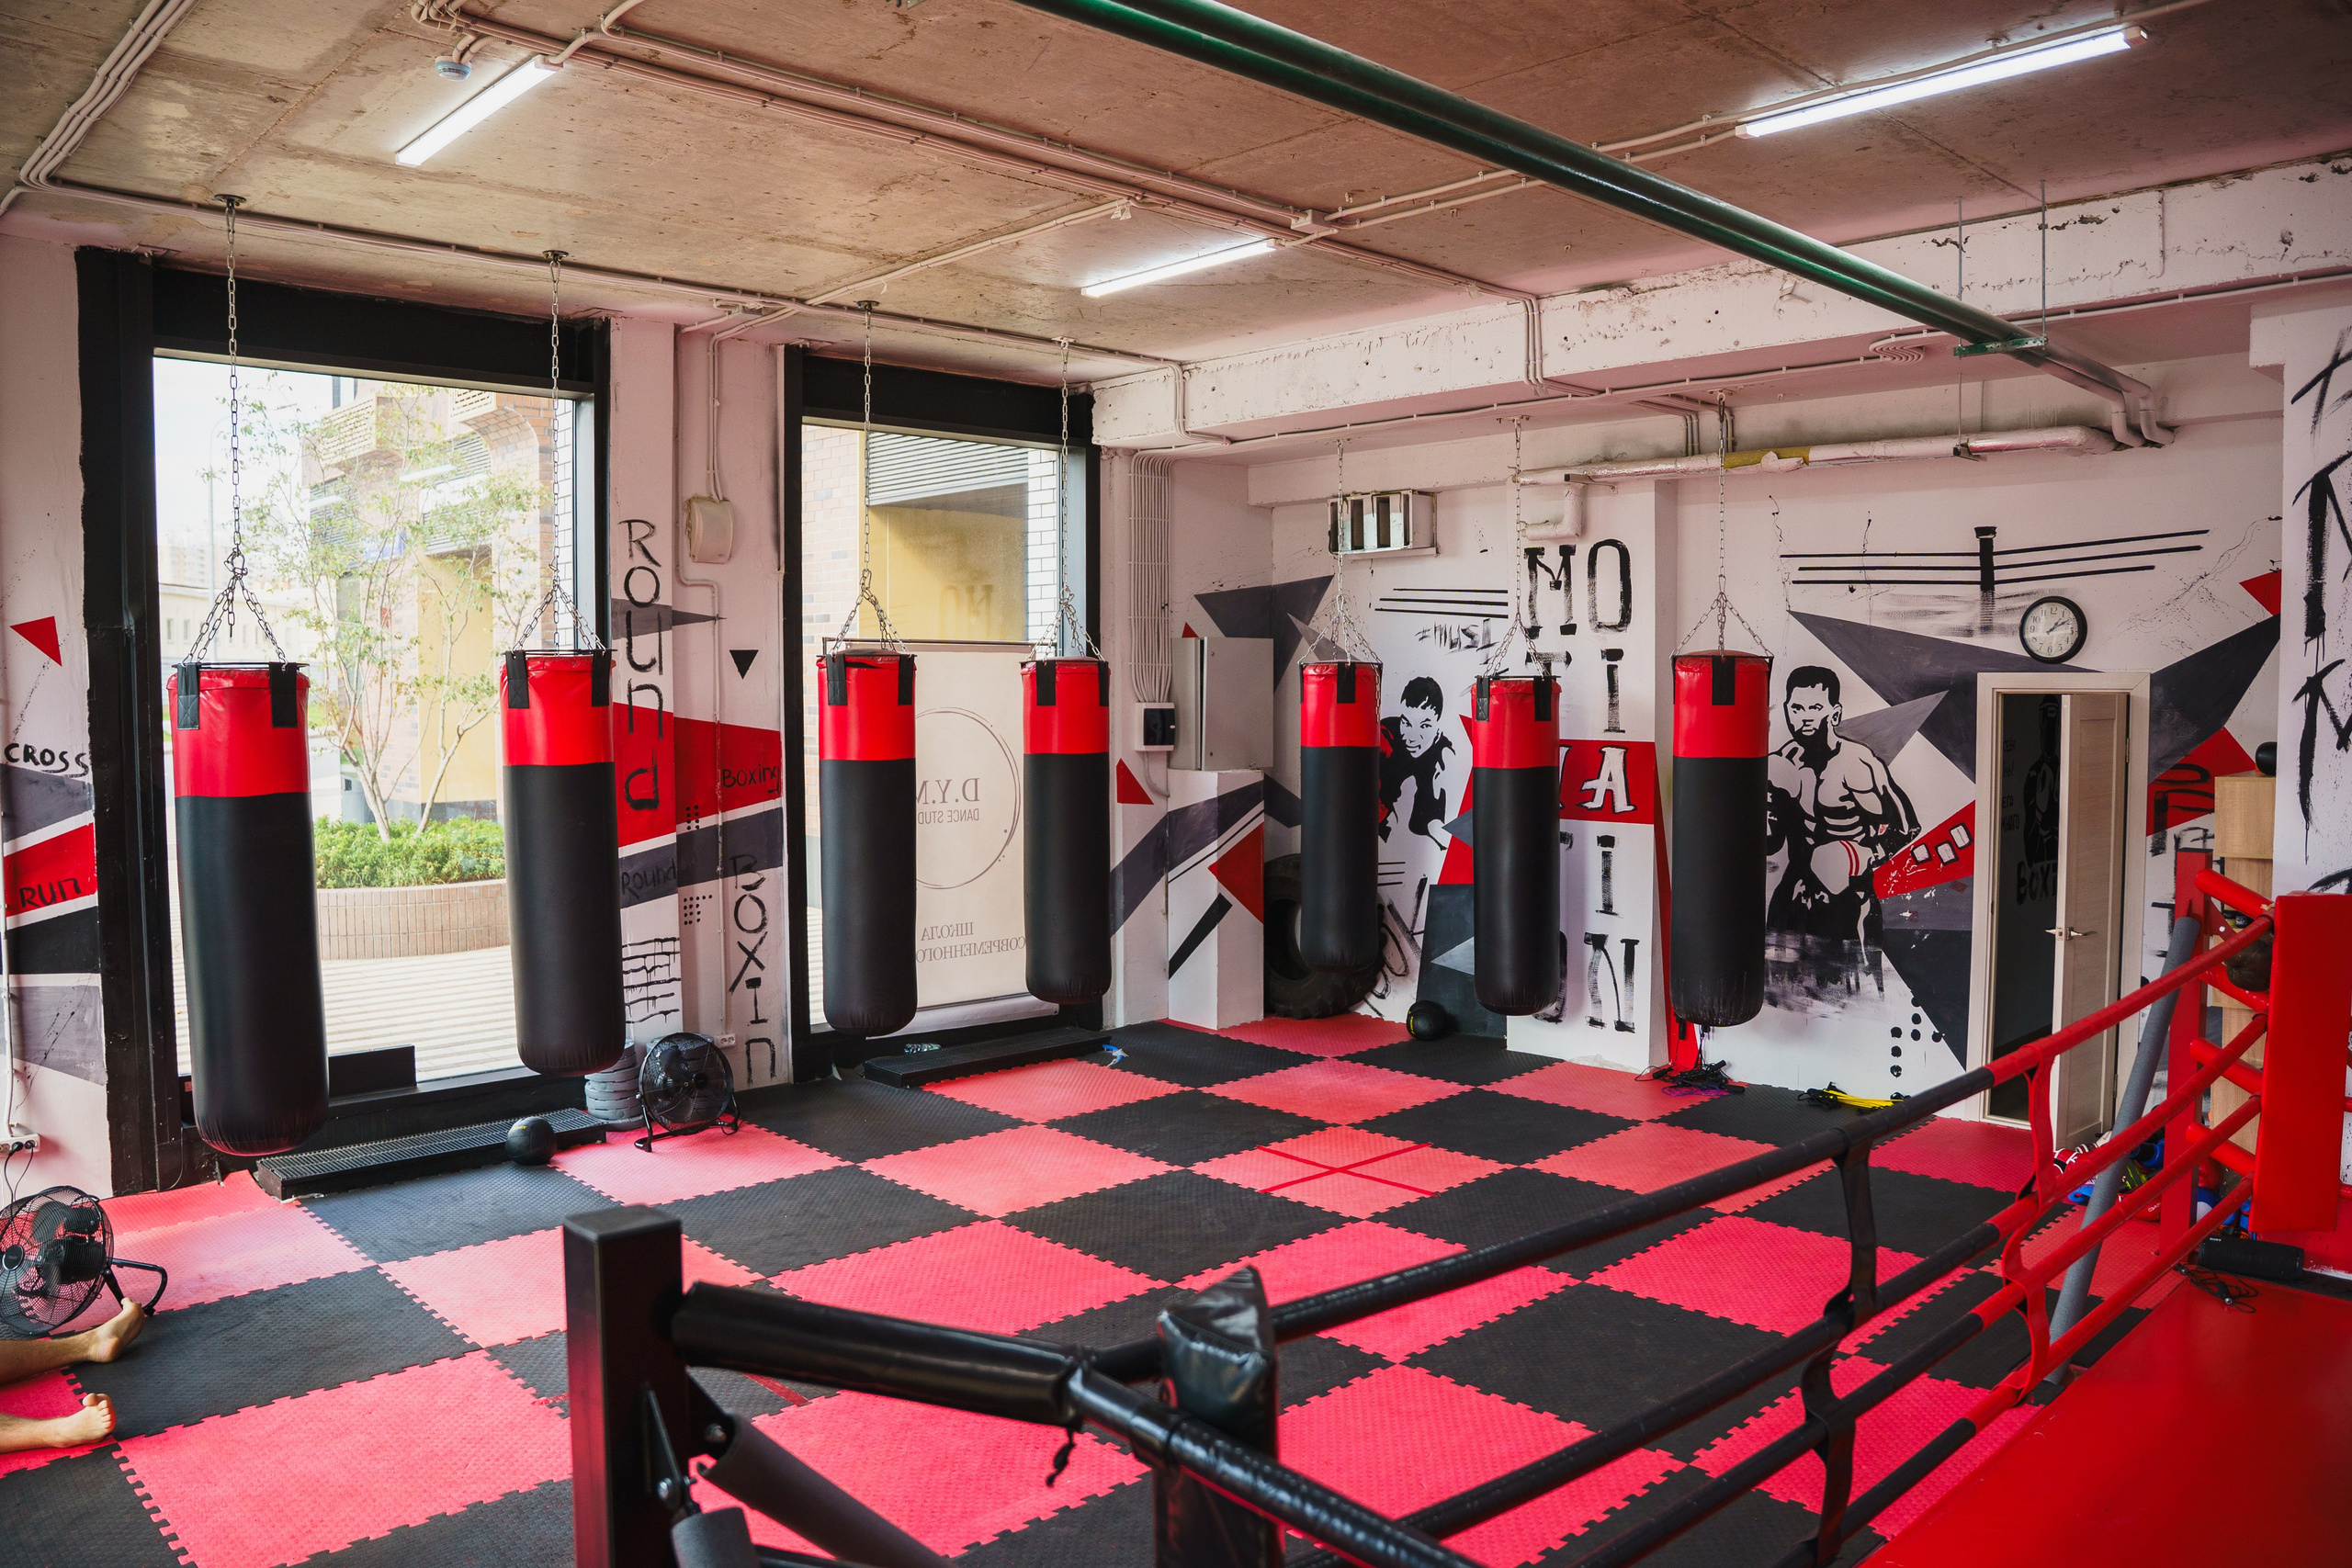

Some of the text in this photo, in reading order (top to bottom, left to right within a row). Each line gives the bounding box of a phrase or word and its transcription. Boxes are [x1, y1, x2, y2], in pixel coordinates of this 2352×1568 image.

[5, 741, 89, 778] CROSS
[722, 763, 780, 795] Boxing
[621, 858, 677, 900] Round
